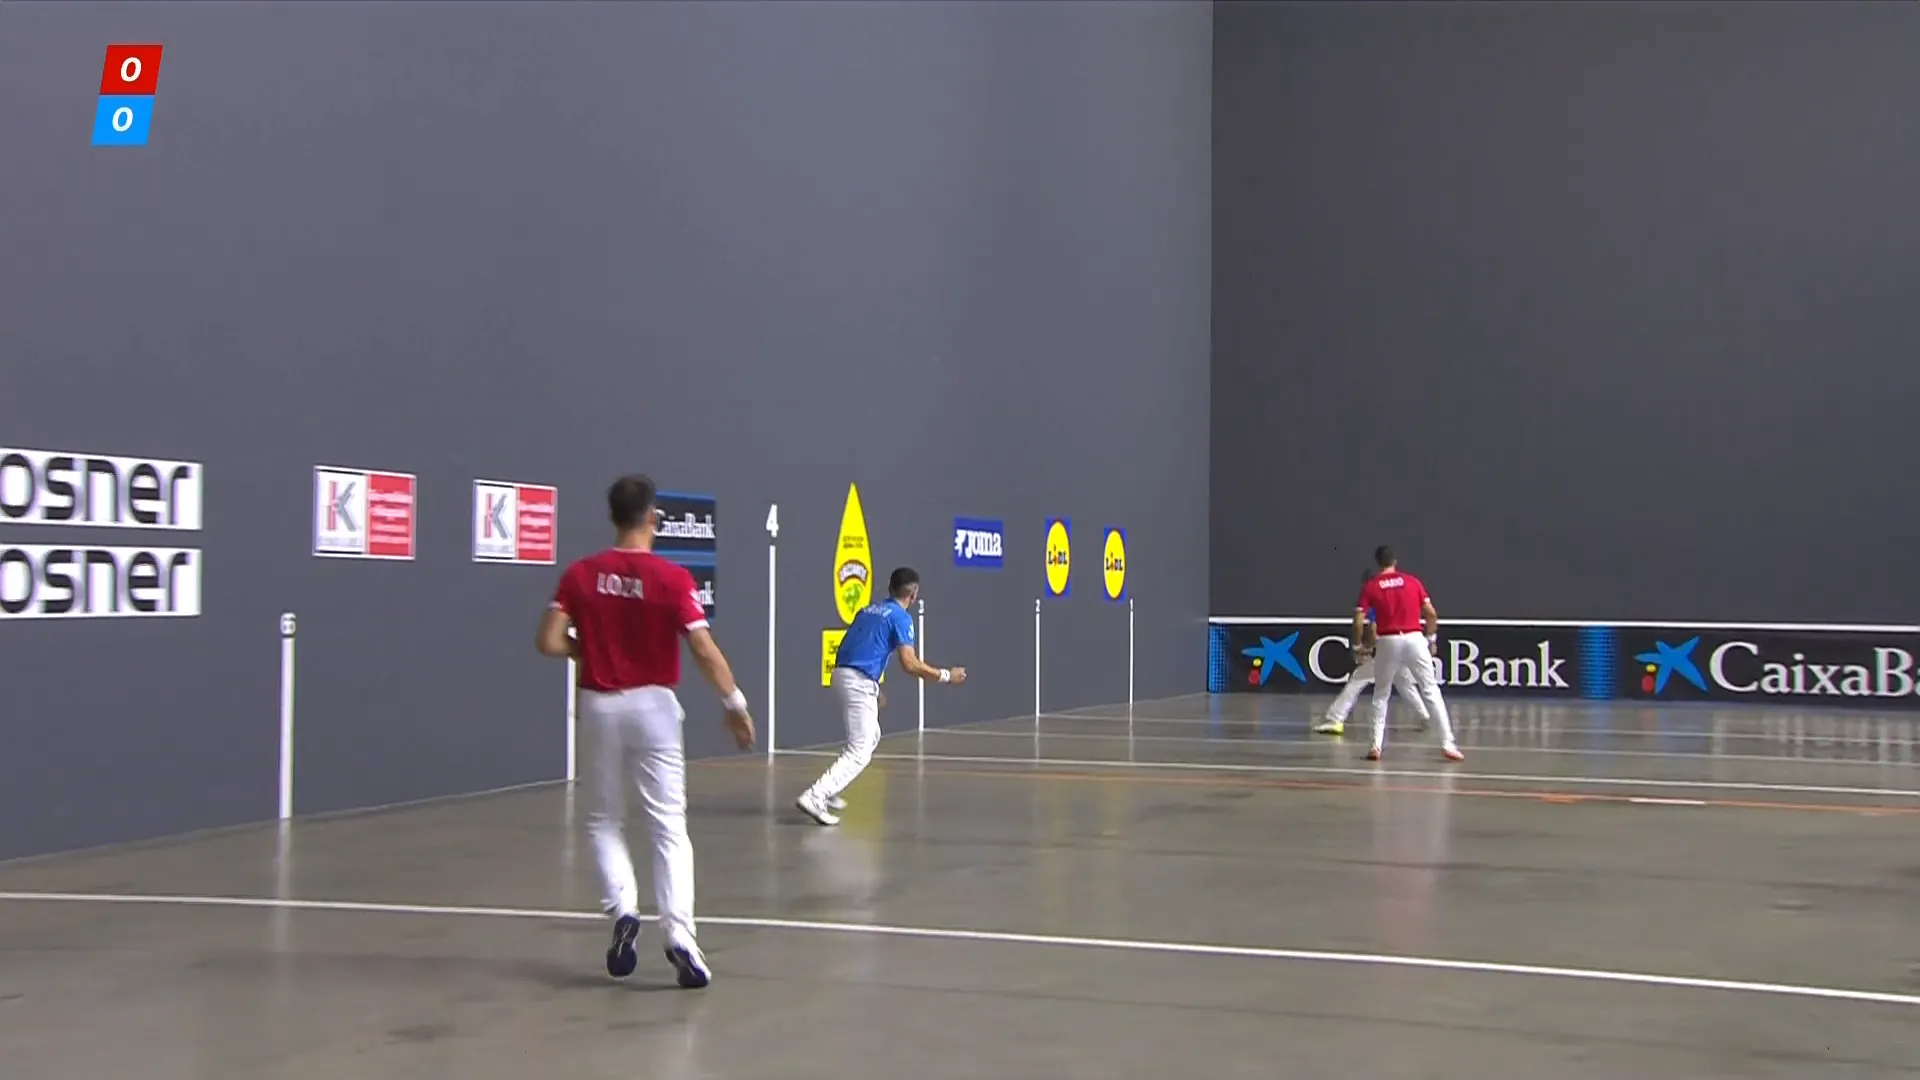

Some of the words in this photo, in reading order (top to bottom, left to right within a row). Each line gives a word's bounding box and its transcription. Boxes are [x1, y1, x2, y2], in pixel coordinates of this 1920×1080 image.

[0, 453, 191, 525] osner
[766, 504, 779, 537] 4
[0, 548, 191, 614] osner
[280, 612, 297, 635] 6
[1709, 641, 1920, 697] CaixaB
